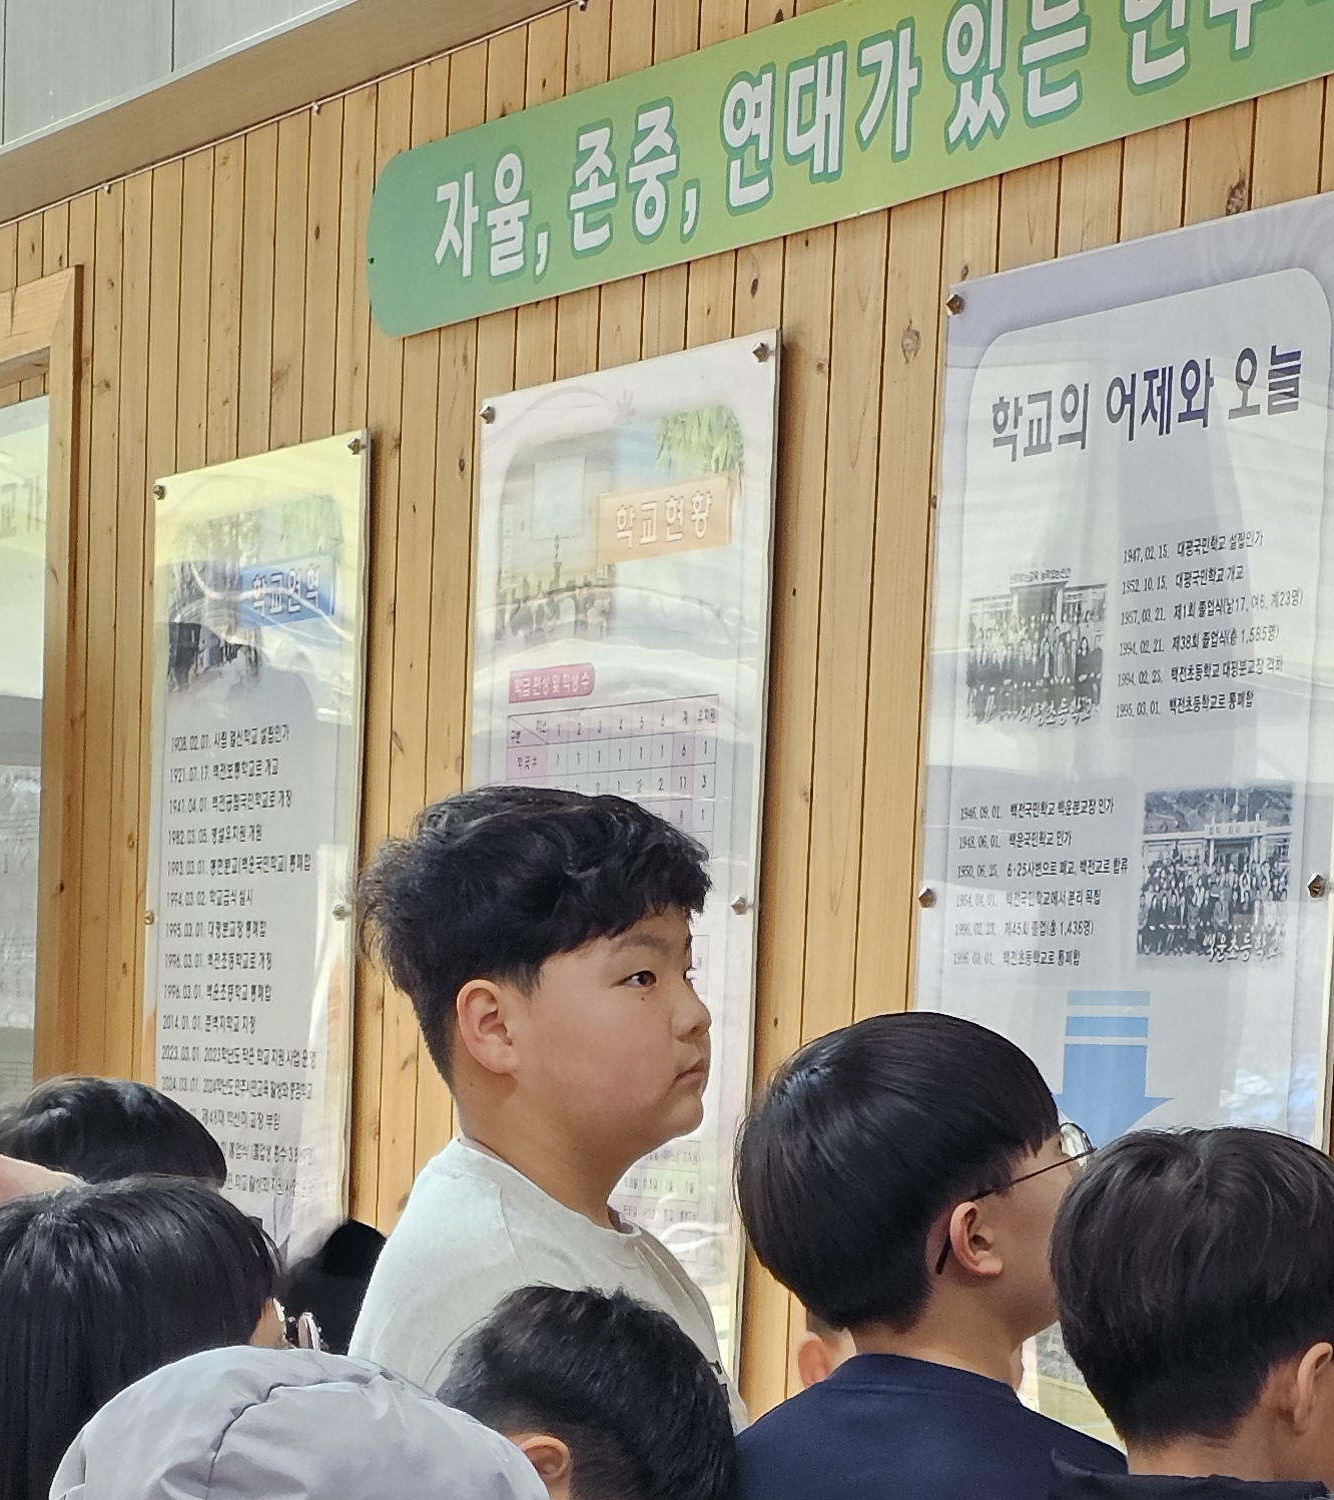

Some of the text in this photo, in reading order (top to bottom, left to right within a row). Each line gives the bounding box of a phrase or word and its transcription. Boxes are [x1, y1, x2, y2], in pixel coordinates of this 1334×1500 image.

[434, 157, 550, 278] 자율,
[568, 104, 700, 253] 존중,
[719, 41, 917, 209] 연대가
[946, 0, 1086, 146] 있는
[992, 344, 1303, 463] 학교의 어제와 오늘
[615, 490, 712, 549] 학교현황
[1171, 663, 1221, 684] 백전초등학교
[1098, 797, 1115, 814] 인가
[1008, 829, 1073, 849] 백운국민학교 인가
